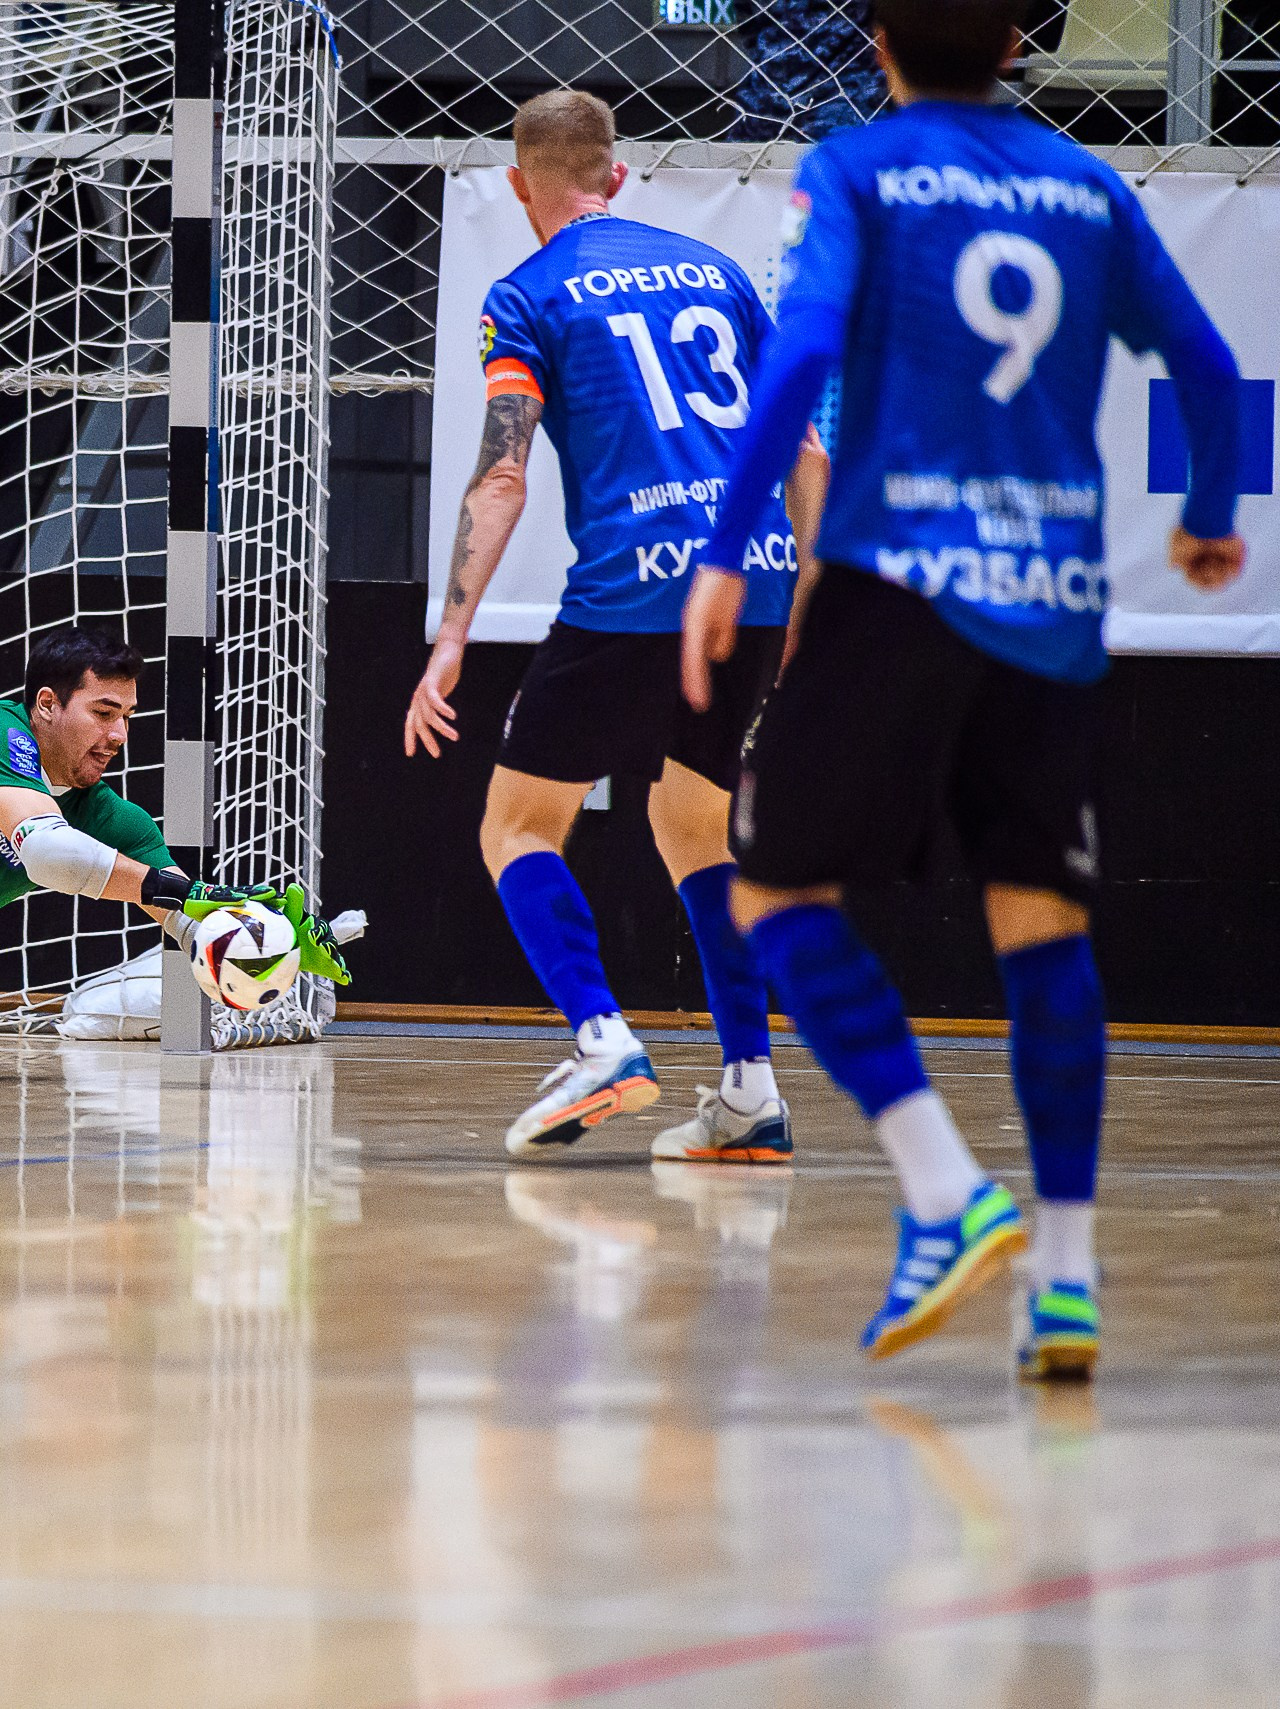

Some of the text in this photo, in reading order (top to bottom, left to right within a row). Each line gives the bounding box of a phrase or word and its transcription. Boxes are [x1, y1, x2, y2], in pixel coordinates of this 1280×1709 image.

[666, 0, 732, 24] ВЫХ
[563, 262, 727, 303] ГОРЕЛОВ
[953, 231, 1064, 404] 9
[606, 305, 751, 431] 13
[636, 533, 798, 581] КУАСС
